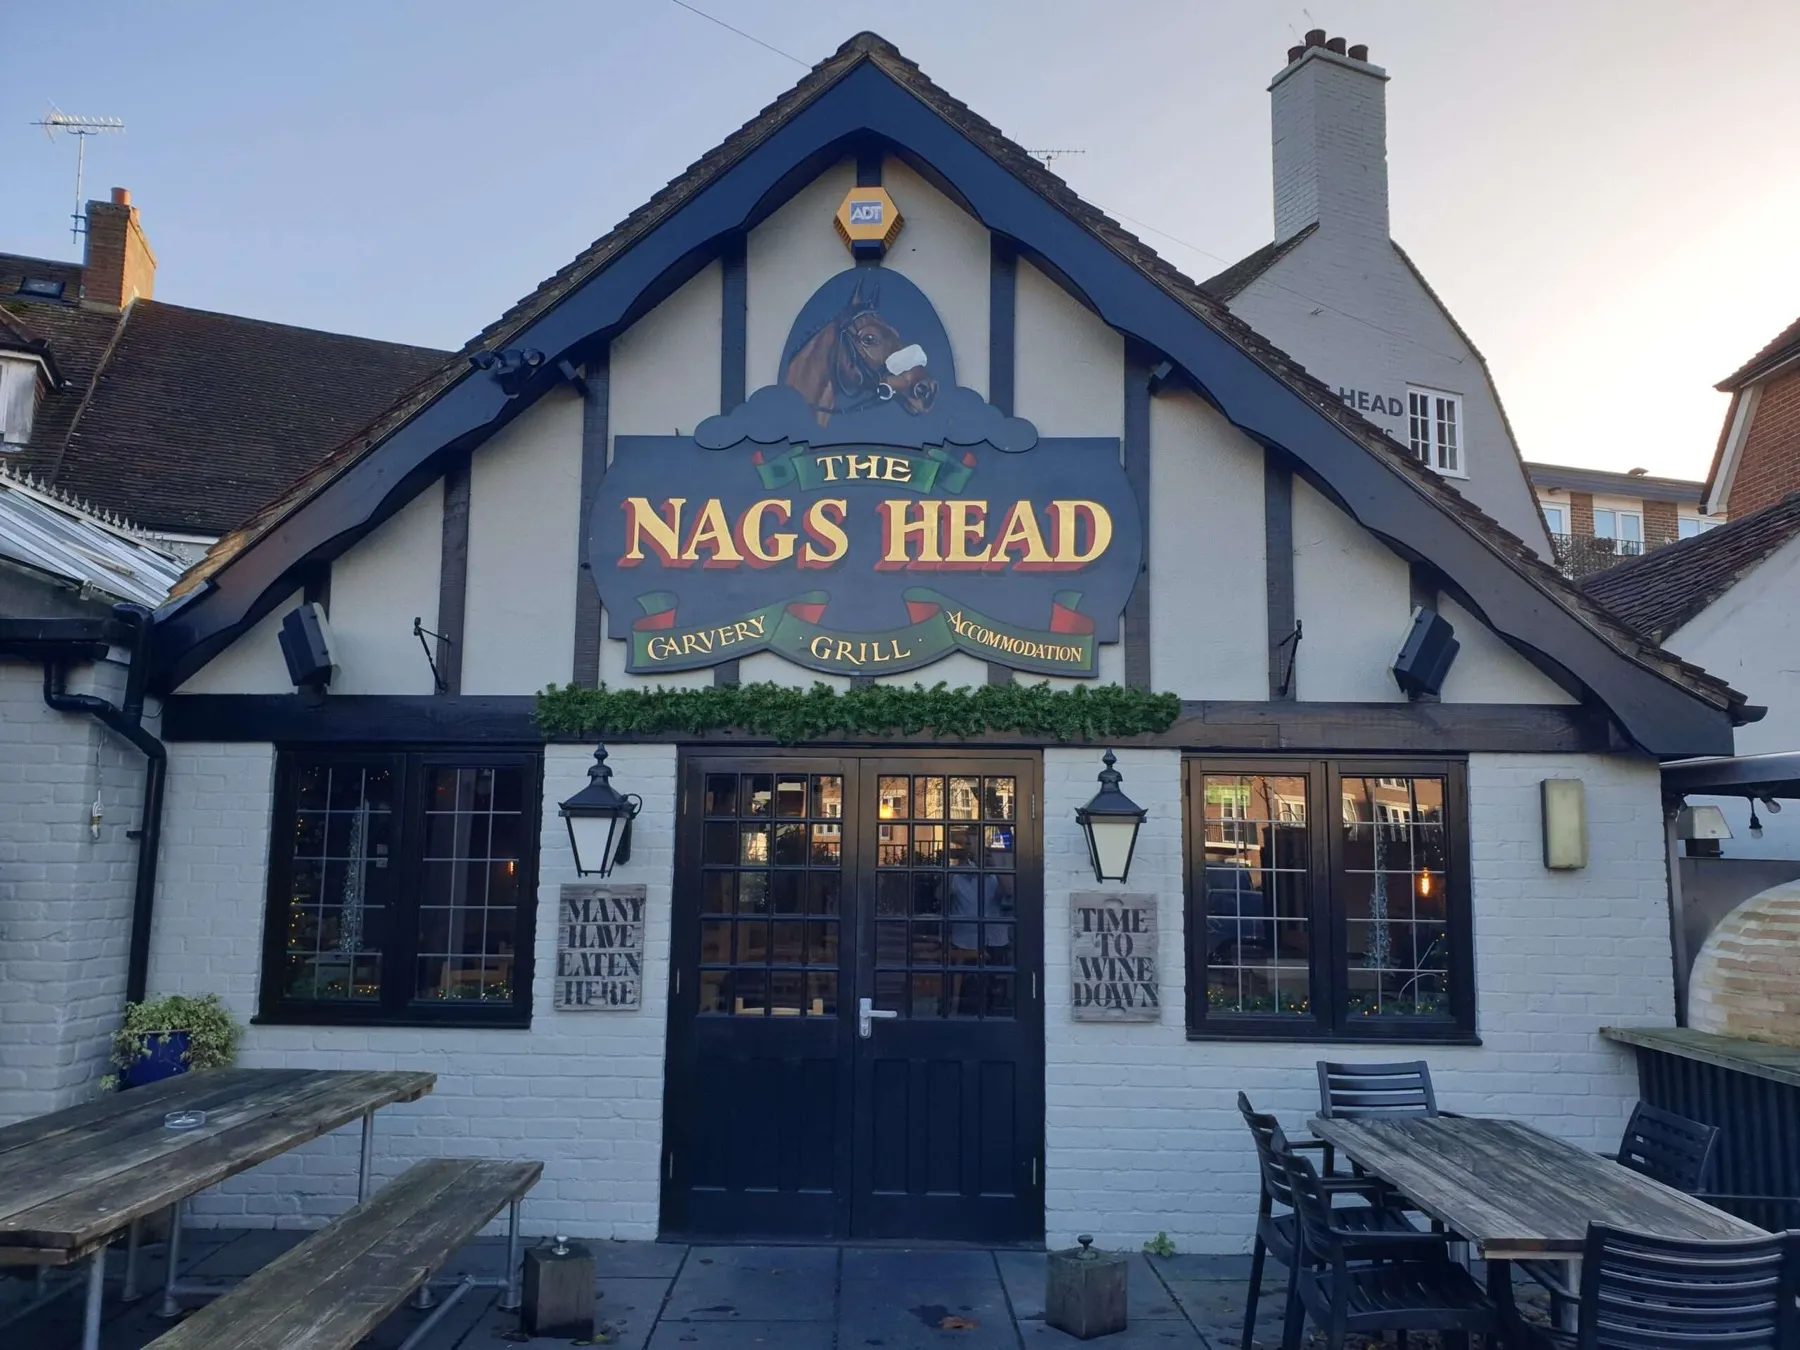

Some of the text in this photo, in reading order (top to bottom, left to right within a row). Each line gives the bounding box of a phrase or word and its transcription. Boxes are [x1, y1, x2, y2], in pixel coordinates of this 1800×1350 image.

[850, 206, 883, 221] ADT
[1339, 387, 1404, 417] HEAD
[816, 455, 912, 483] THE
[617, 497, 1113, 571] NAGS HEAD
[647, 615, 766, 661] CARVERY
[945, 610, 1083, 663] ACCOMMODATION
[810, 636, 911, 665] GRILL
[566, 898, 645, 922] MANY
[1078, 908, 1148, 933] TIME
[568, 924, 635, 948] HAVE
[1096, 933, 1134, 957] TO
[558, 952, 641, 976] EATEN
[1077, 956, 1154, 982] WINE
[564, 981, 635, 1005] HERE
[1073, 982, 1159, 1008] DOWN
